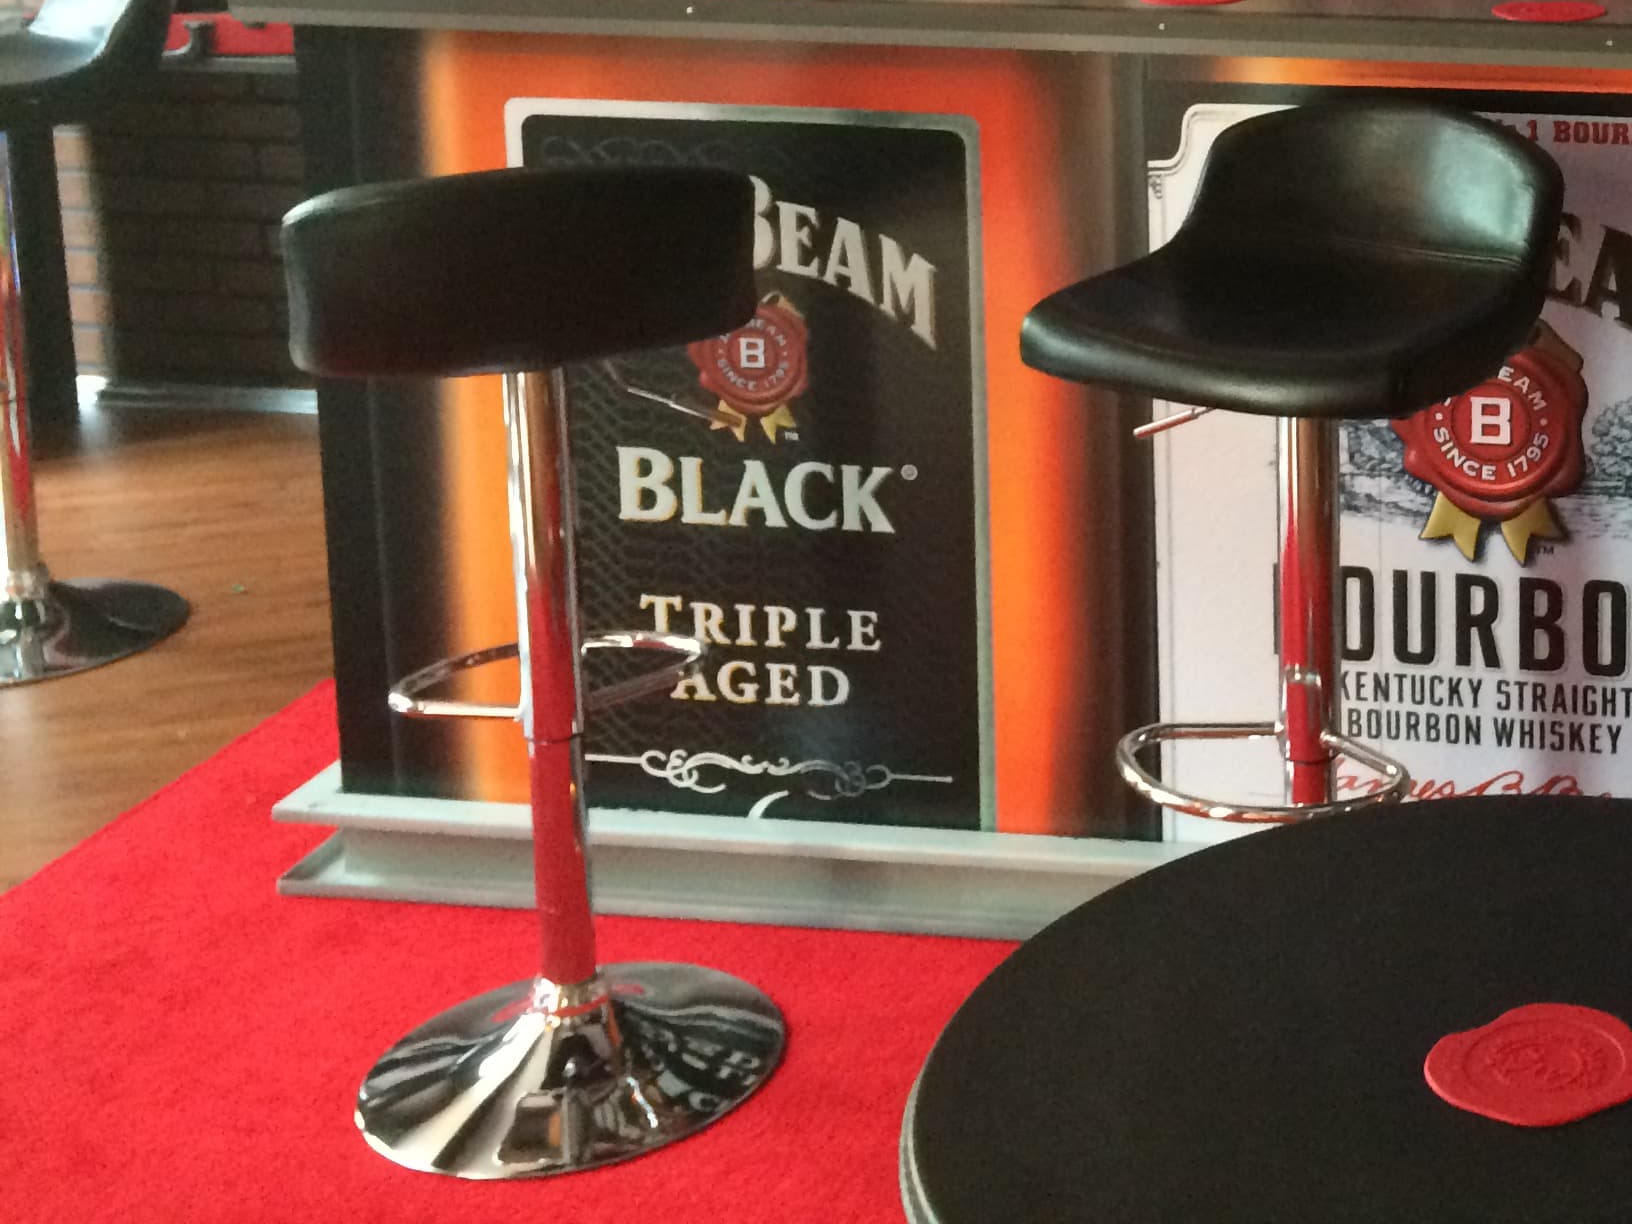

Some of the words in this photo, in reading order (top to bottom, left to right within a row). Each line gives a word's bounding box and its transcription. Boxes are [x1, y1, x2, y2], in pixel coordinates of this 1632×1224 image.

[739, 336, 766, 369] B
[1497, 365, 1548, 411] EAM
[1470, 396, 1512, 446] B
[1433, 426, 1497, 481] SINCE
[1506, 432, 1549, 478] 1795
[615, 444, 896, 534] BLACK
[639, 592, 882, 652] TRIPLE
[669, 661, 851, 708] AGED
[1347, 707, 1482, 746] BOURBON
[1493, 716, 1623, 755] WHISKEY
